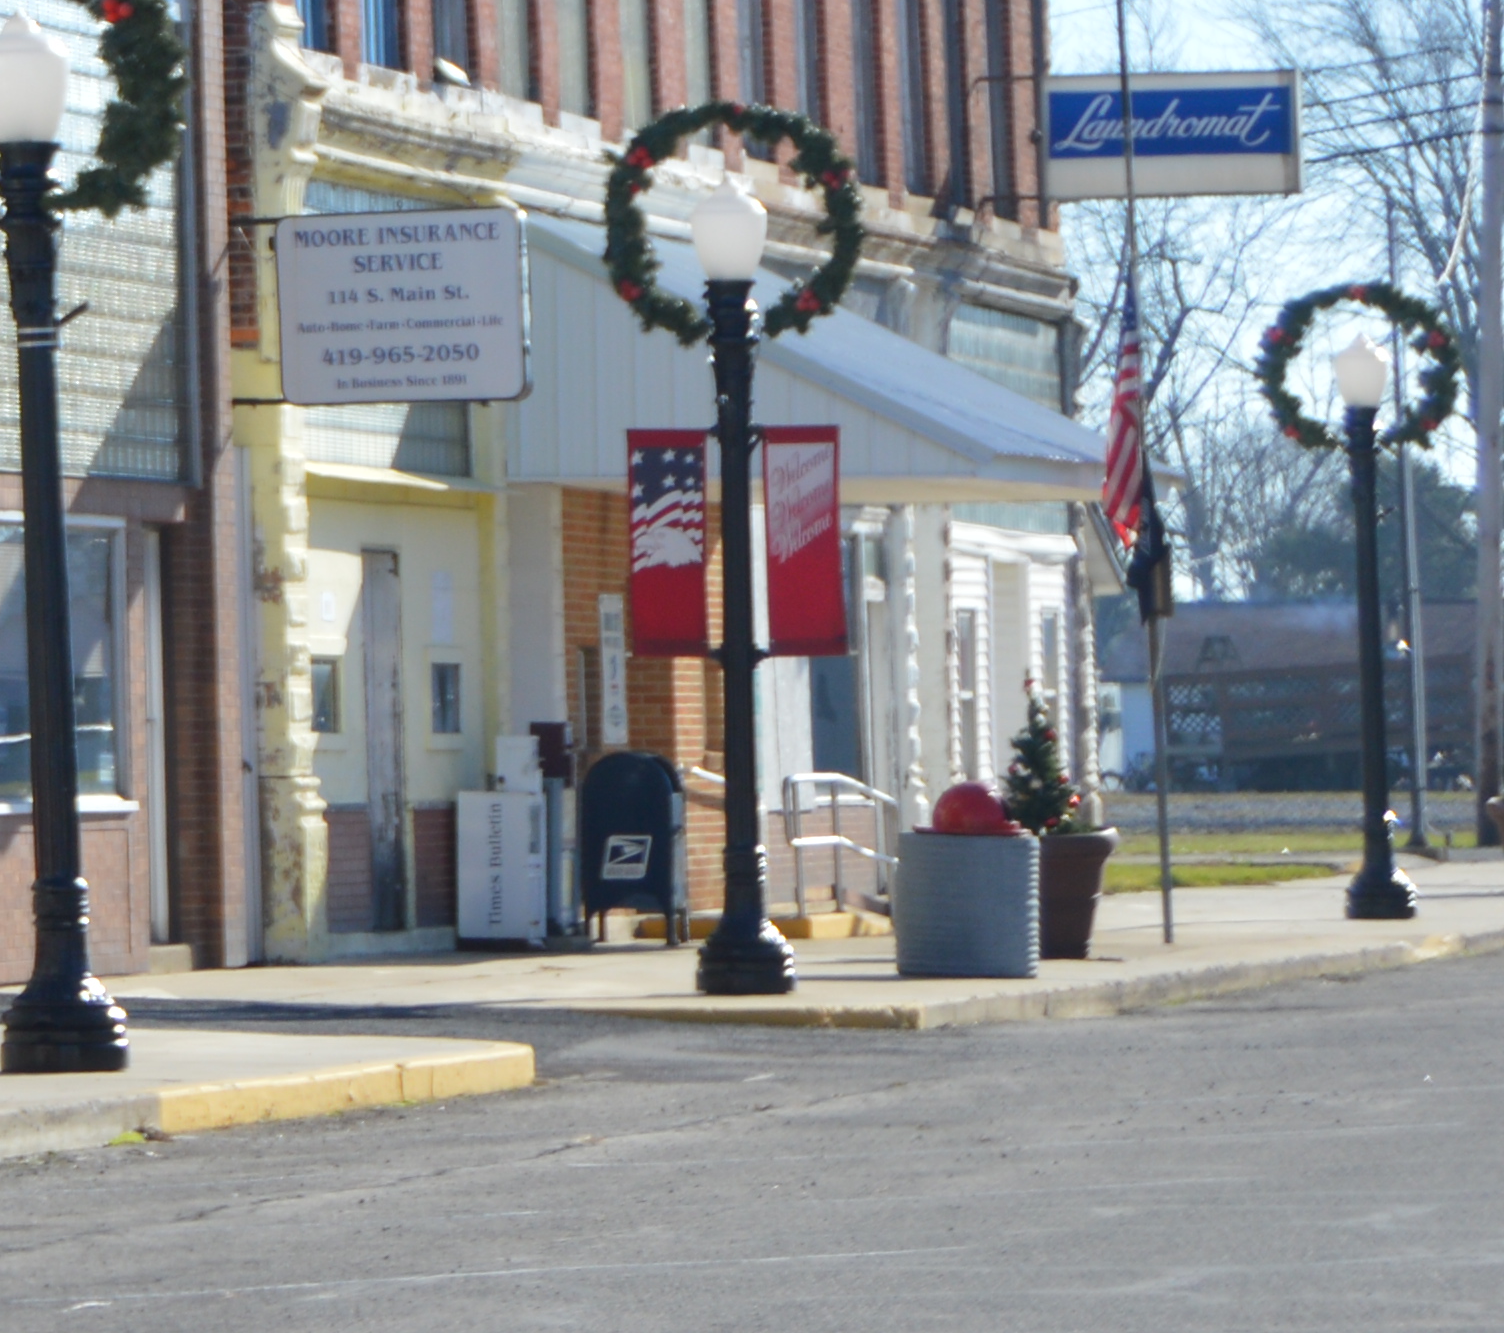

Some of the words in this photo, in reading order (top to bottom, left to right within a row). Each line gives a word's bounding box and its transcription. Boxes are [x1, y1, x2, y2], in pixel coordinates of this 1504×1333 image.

[1054, 92, 1282, 151] Laundromat
[294, 228, 370, 248] MOORE
[378, 222, 501, 245] INSURANCE
[353, 252, 443, 273] SERVICE
[327, 288, 359, 305] 114
[366, 286, 384, 303] S.
[391, 285, 436, 302] Main
[444, 284, 470, 301] St.
[321, 343, 480, 366] 419-965-2050
[352, 377, 404, 389] Business
[406, 375, 438, 387] Since
[488, 802, 502, 868] Bulletin
[488, 874, 502, 925] Times
